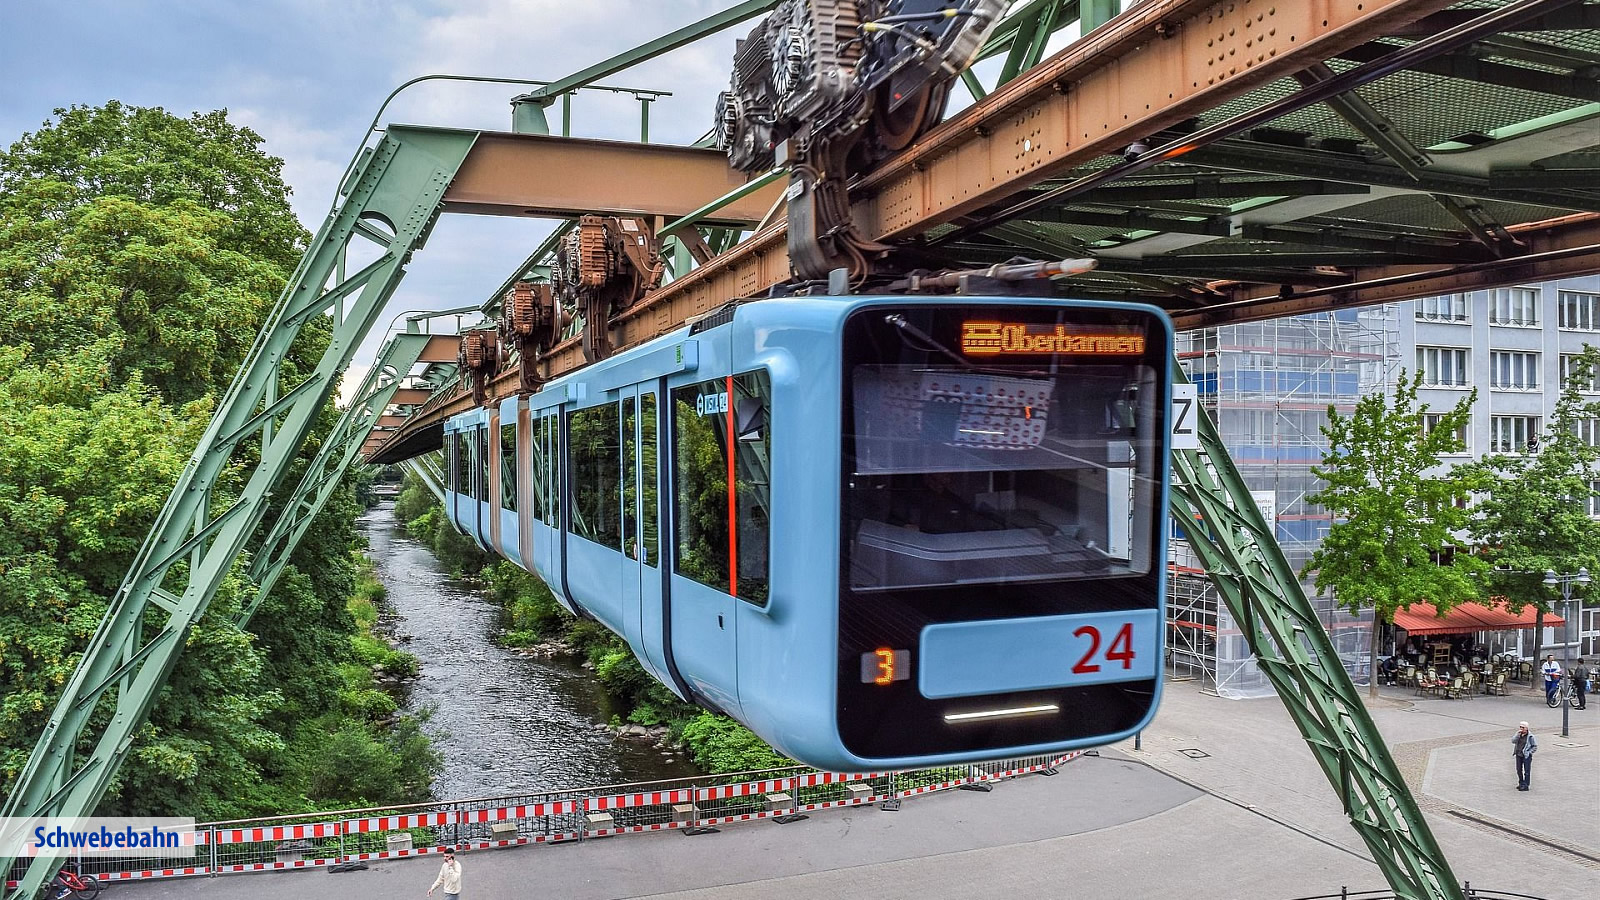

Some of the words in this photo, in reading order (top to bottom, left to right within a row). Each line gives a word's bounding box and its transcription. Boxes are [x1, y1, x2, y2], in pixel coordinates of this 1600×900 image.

[1001, 325, 1145, 352] Oberbarmen
[1172, 398, 1192, 434] Z
[1071, 622, 1135, 674] 24
[875, 649, 893, 683] 3
